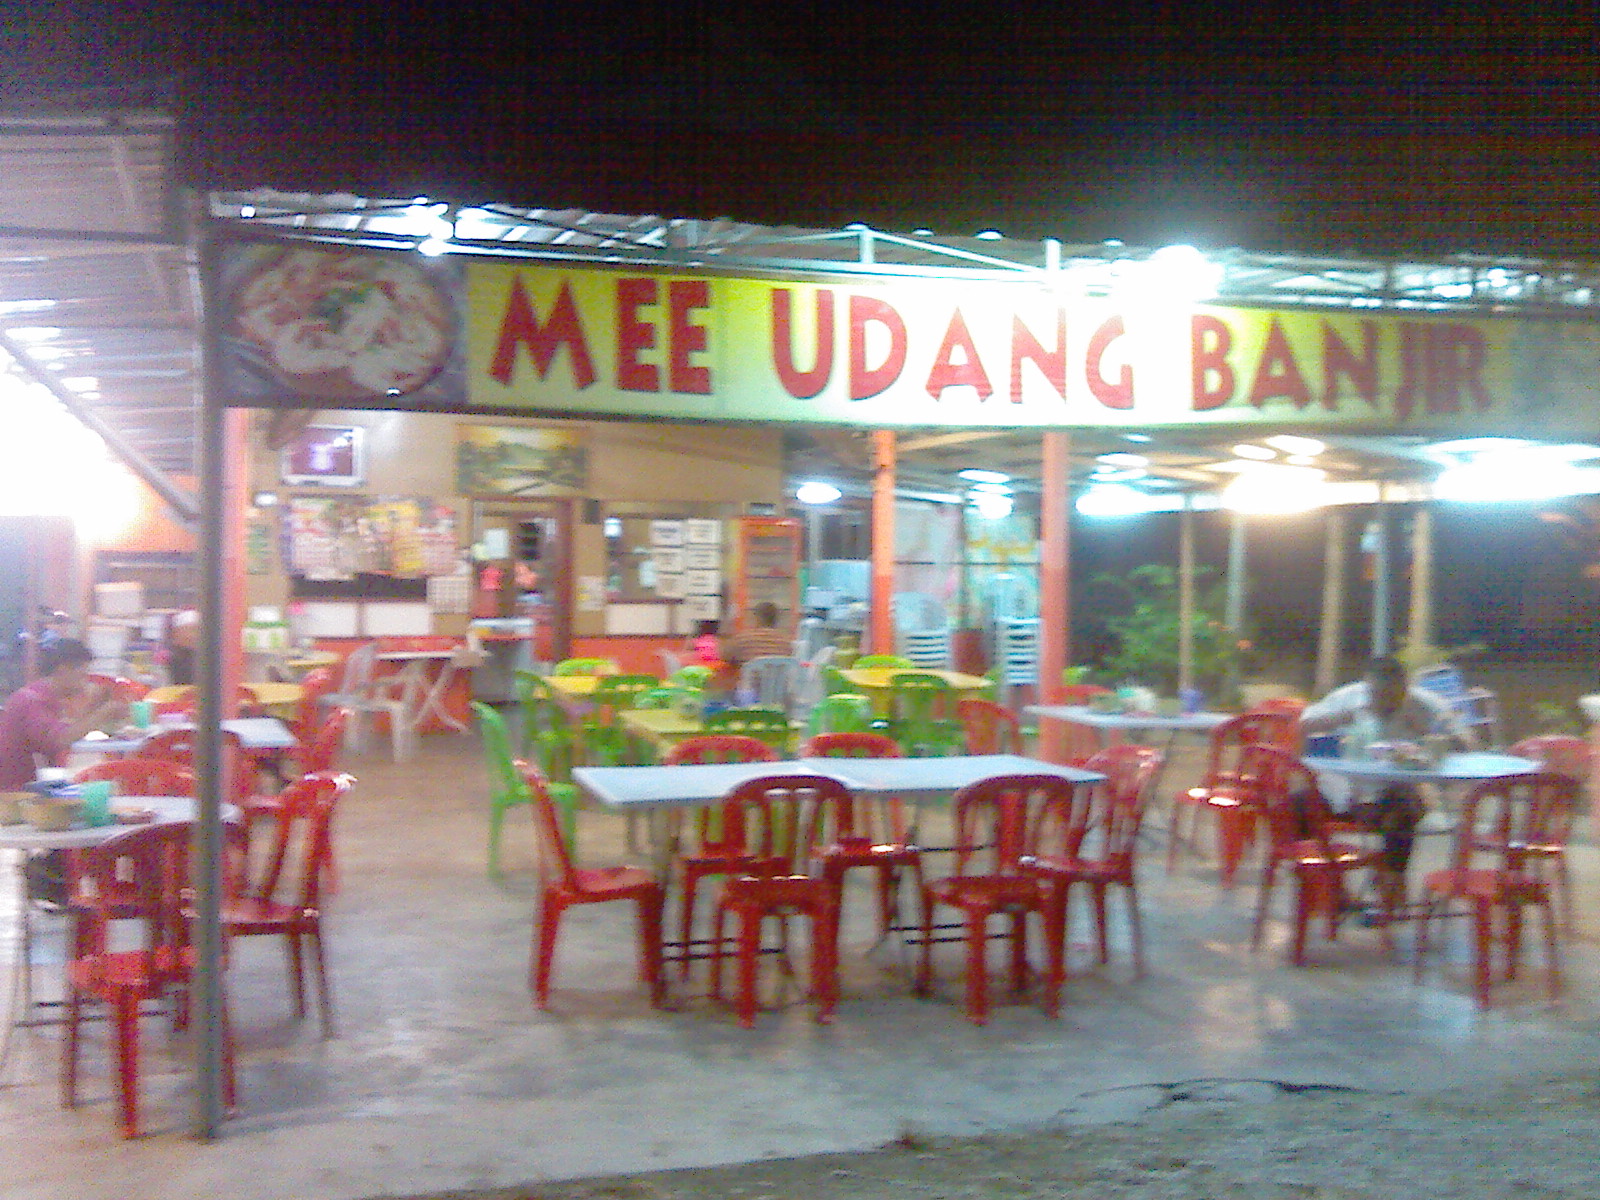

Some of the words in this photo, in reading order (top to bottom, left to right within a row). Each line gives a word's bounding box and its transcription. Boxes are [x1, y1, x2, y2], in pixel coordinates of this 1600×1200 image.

[488, 271, 712, 394] MEE
[771, 287, 1135, 409] UDANG
[1191, 308, 1492, 422] BANJIR
